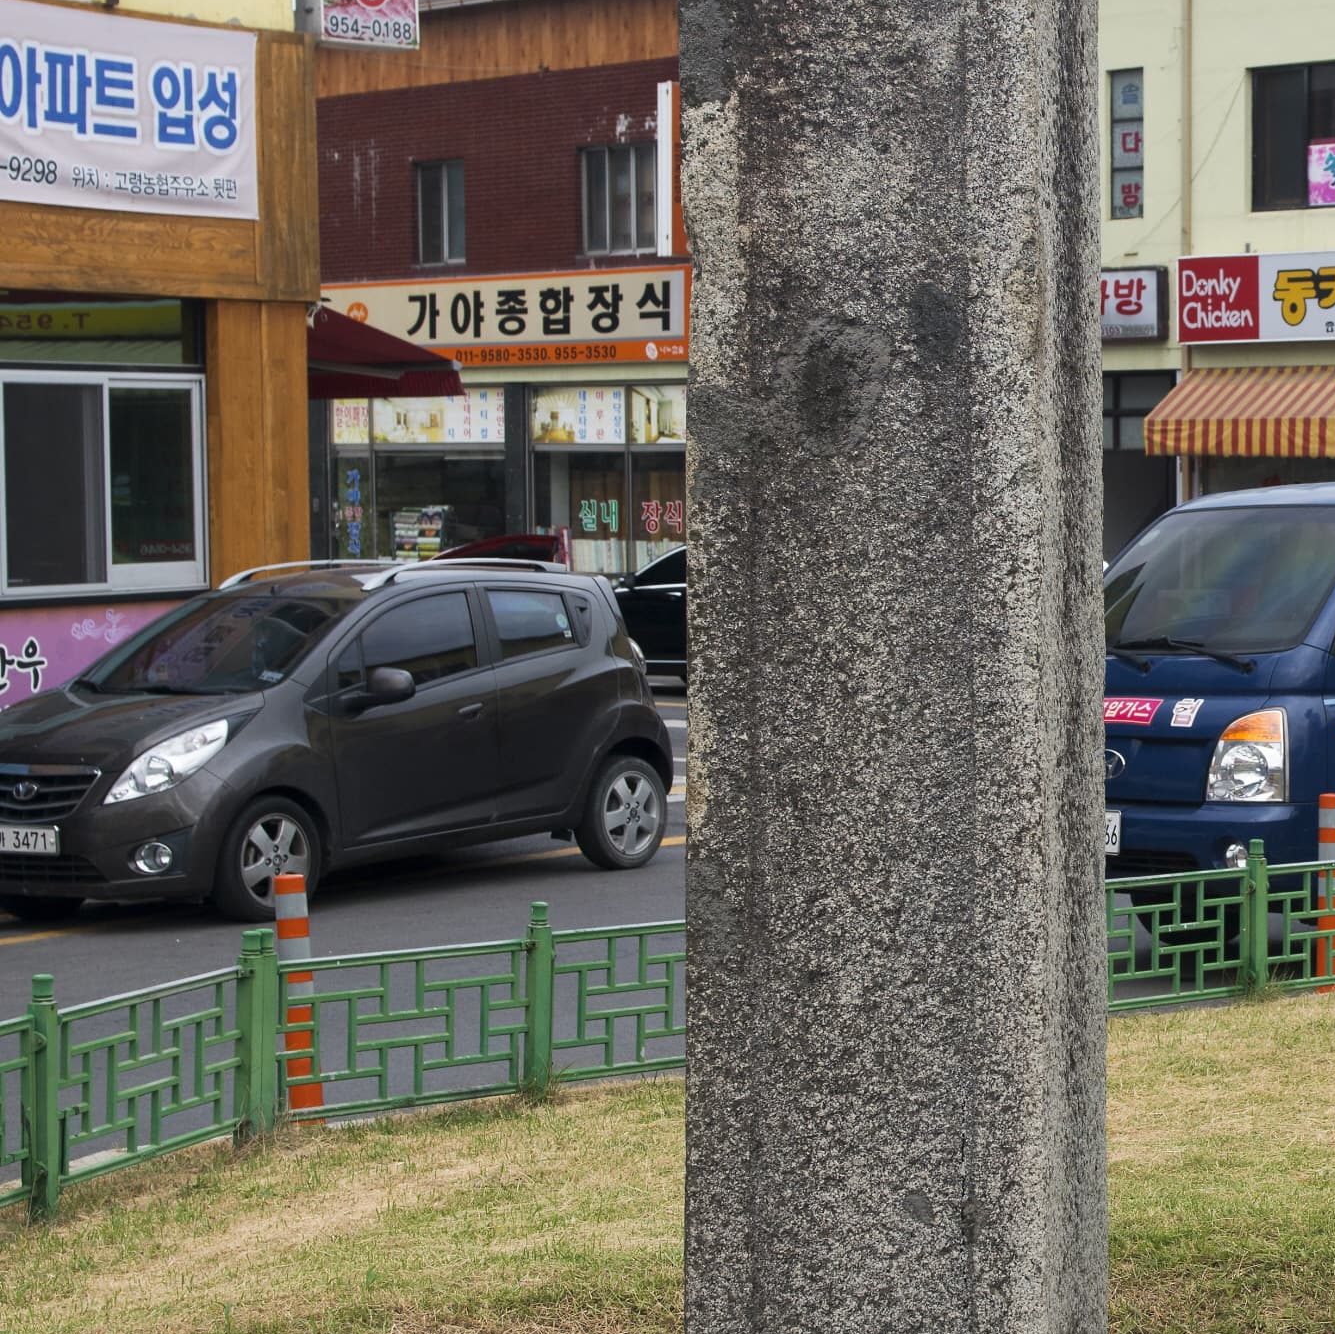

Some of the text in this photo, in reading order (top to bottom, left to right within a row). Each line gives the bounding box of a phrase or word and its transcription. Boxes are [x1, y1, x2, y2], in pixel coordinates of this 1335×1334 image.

[329, 15, 412, 41] 954-0188
[0, 43, 238, 150] 아파트 입성
[72, 165, 100, 190] 위치
[114, 171, 210, 199] 고령농협주유소
[212, 178, 238, 200] 뒷편
[1182, 268, 1241, 303] Donky
[406, 280, 673, 340] 가야종합장식
[1182, 298, 1254, 329] Chicken
[554, 344, 617, 361] 955-3530
[578, 498, 683, 534] 실내 장식
[12, 830, 47, 850] 3471
